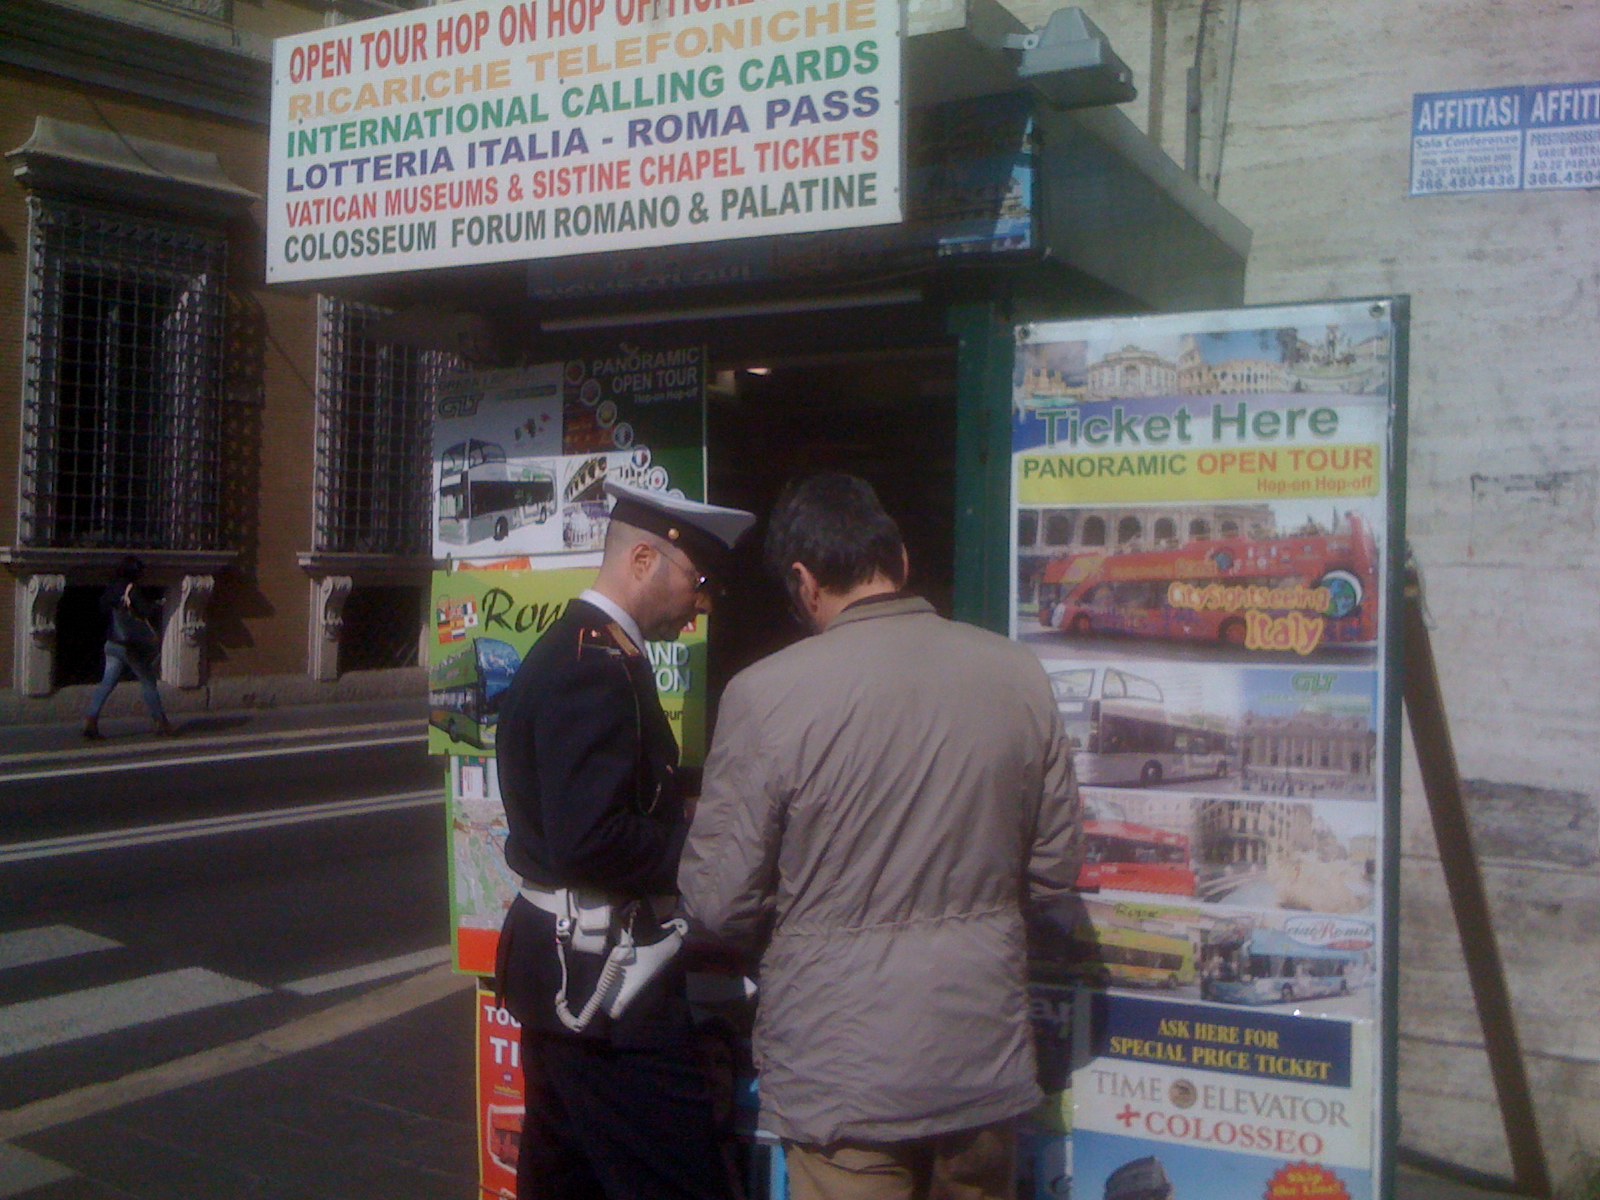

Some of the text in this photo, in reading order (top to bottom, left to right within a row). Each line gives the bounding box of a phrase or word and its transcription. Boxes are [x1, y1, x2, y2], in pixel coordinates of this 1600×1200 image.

[288, 0, 876, 121] RICARICHE TELEFONICHE
[290, 37, 352, 84] OPEN
[361, 22, 427, 71] TOUR
[437, 11, 489, 58] HOP
[499, 1, 536, 46] ON
[547, 0, 605, 38] HOP
[287, 40, 879, 158] INTERNATIONAL CALLING CARDS
[1418, 94, 1520, 132] AFFITTASI
[286, 146, 454, 193] LOTTERIA
[467, 127, 589, 169] ITALIA
[628, 105, 750, 149] ROMA
[766, 86, 880, 130] PASS
[286, 129, 879, 229] VATICAN MUSEUMS & SISTINE CHAPEL TICKETS
[285, 172, 877, 265] COLOSSEUM FORUM ROMANO & PALATINE
[592, 348, 700, 376] PANORAMIC
[612, 366, 698, 394] OPEN TOUR
[1036, 401, 1340, 448] Ticket Here
[1023, 448, 1373, 479] PANORAMIC OPEN TOUR
[1257, 474, 1372, 495] Hop-on Hop-off
[1245, 610, 1324, 656] Italy
[653, 667, 690, 692] ON
[489, 1035, 519, 1068] TI
[1158, 1018, 1280, 1049] ASK HERE FOR
[1109, 1036, 1332, 1080] SPECIAL PRICE TICKET
[1093, 1070, 1350, 1128] TIME ELEVATOR
[1145, 1110, 1324, 1156] COLOSSEO
